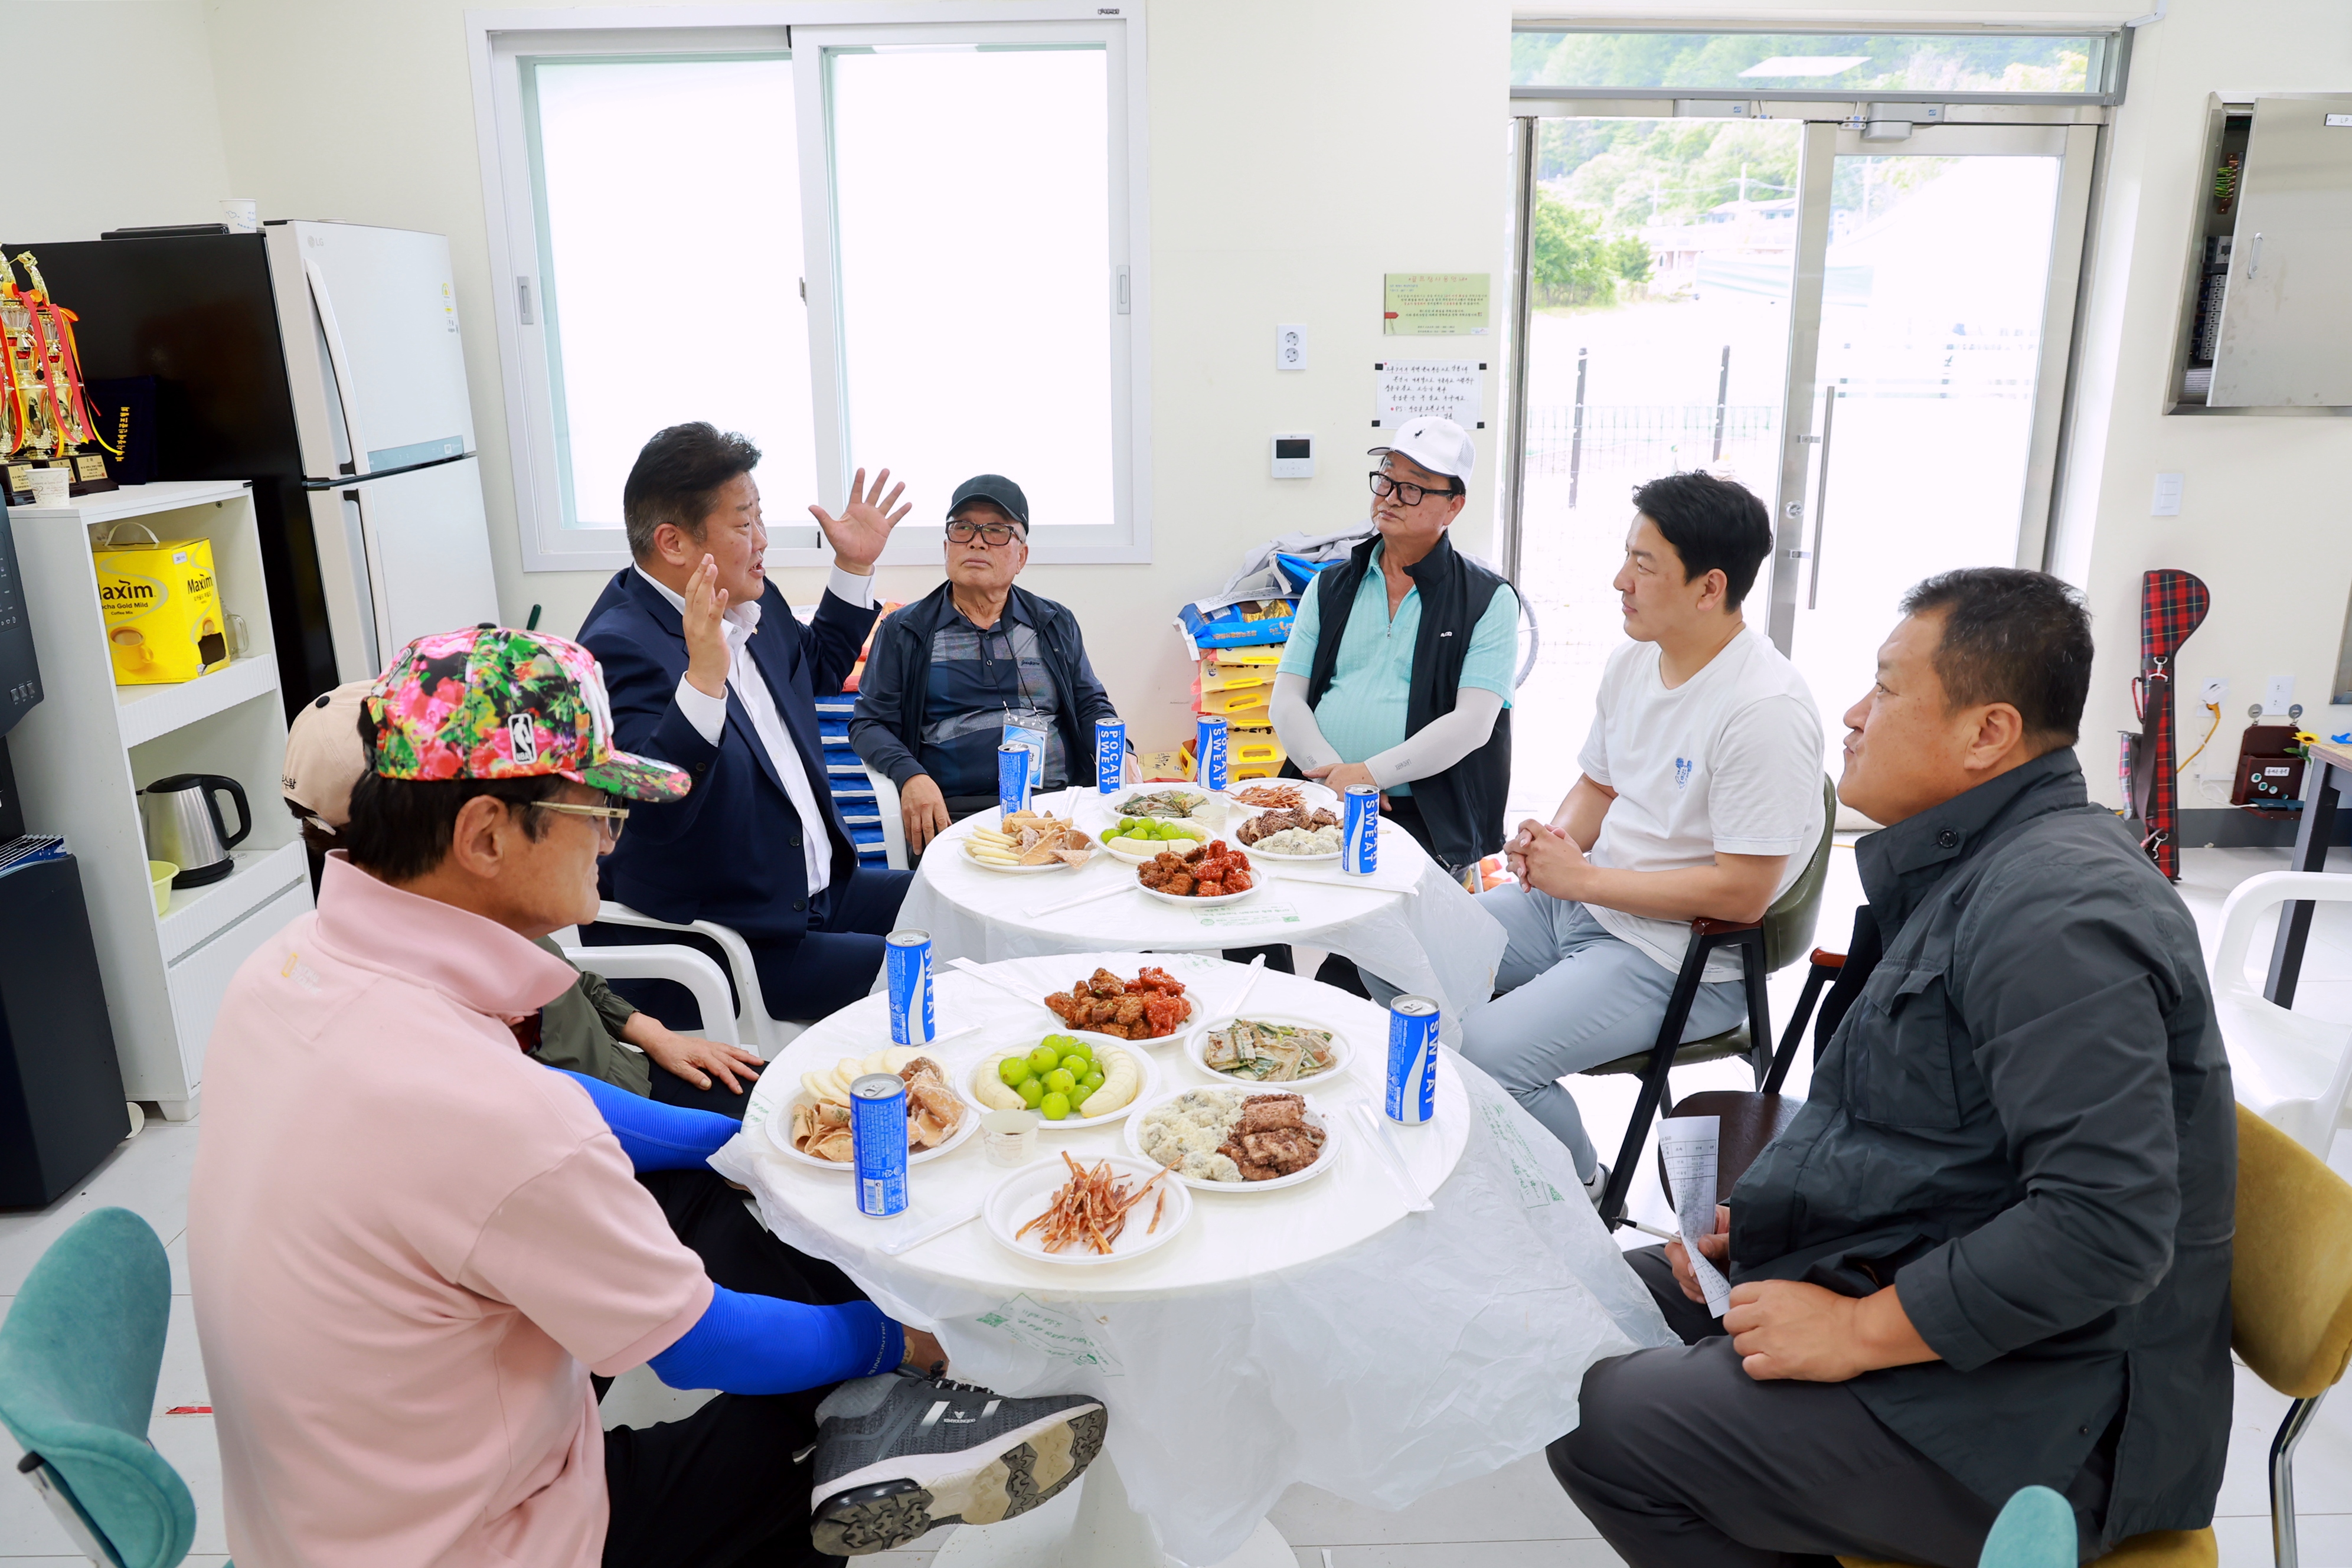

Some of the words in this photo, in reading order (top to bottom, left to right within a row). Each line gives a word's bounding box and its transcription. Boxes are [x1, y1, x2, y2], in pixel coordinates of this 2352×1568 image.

[315, 237, 324, 247] LG
[97, 579, 153, 600] axim
[187, 573, 213, 595] Maxim
[515, 752, 530, 762] NBA
[1100, 730, 1110, 785] SWEAT
[1109, 730, 1119, 792] POCARI
[1213, 728, 1222, 782] SWEAT
[1364, 799, 1374, 863] SWEAT
[925, 947, 935, 1024] SWEAT
[1425, 1020, 1439, 1104] SWEAT
